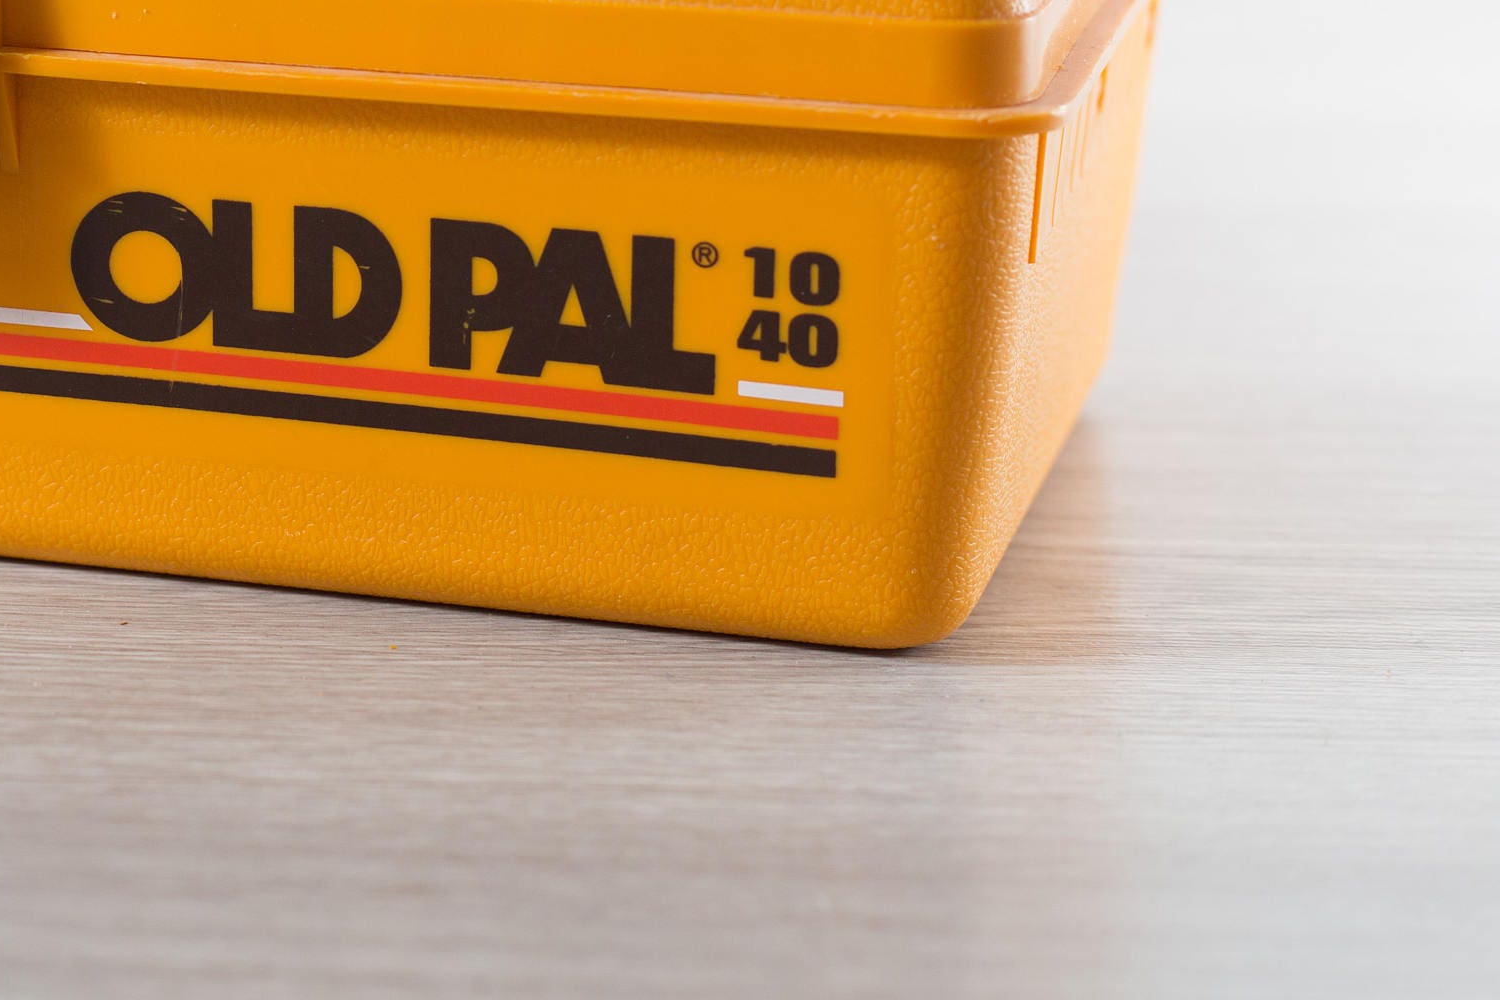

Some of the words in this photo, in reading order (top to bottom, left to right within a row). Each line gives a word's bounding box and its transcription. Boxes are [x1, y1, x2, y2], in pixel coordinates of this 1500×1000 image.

[69, 190, 404, 359] OLD
[743, 246, 841, 307] 10
[736, 309, 840, 369] 40
